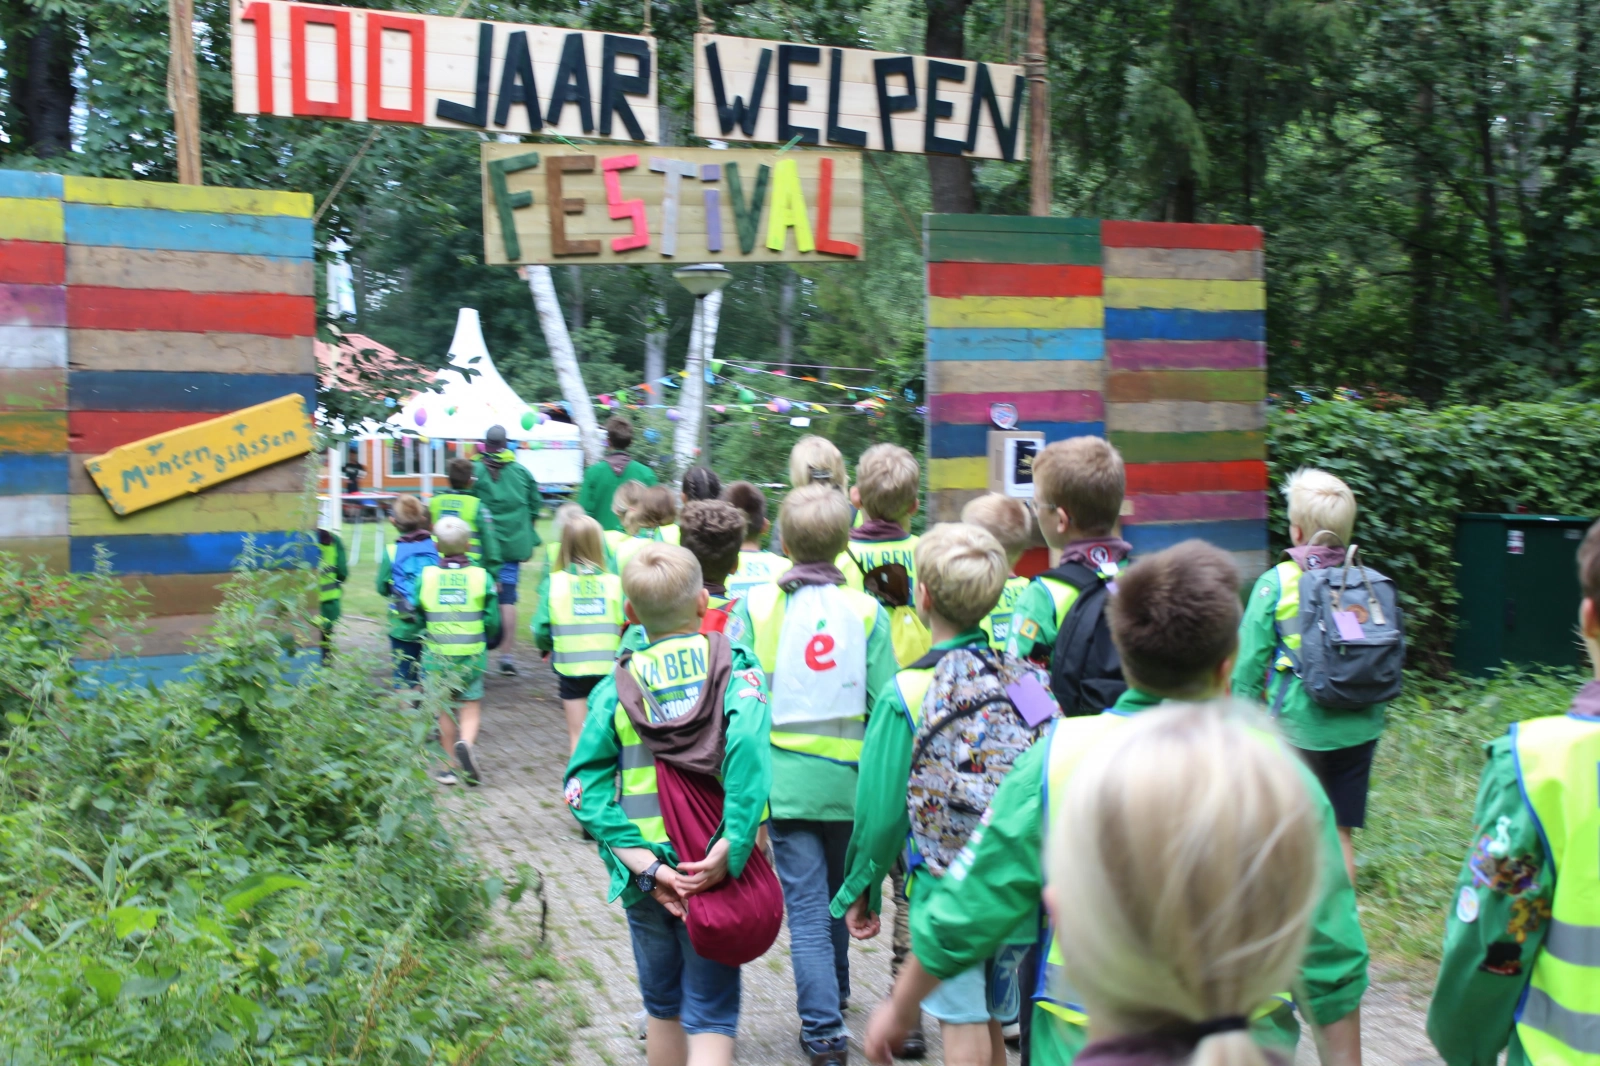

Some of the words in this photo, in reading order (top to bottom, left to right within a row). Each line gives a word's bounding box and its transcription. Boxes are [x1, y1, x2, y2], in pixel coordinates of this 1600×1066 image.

[241, 2, 426, 125] 100
[435, 22, 650, 141] JAAR
[704, 41, 1025, 163] WELPEN
[663, 648, 706, 681] BEN
